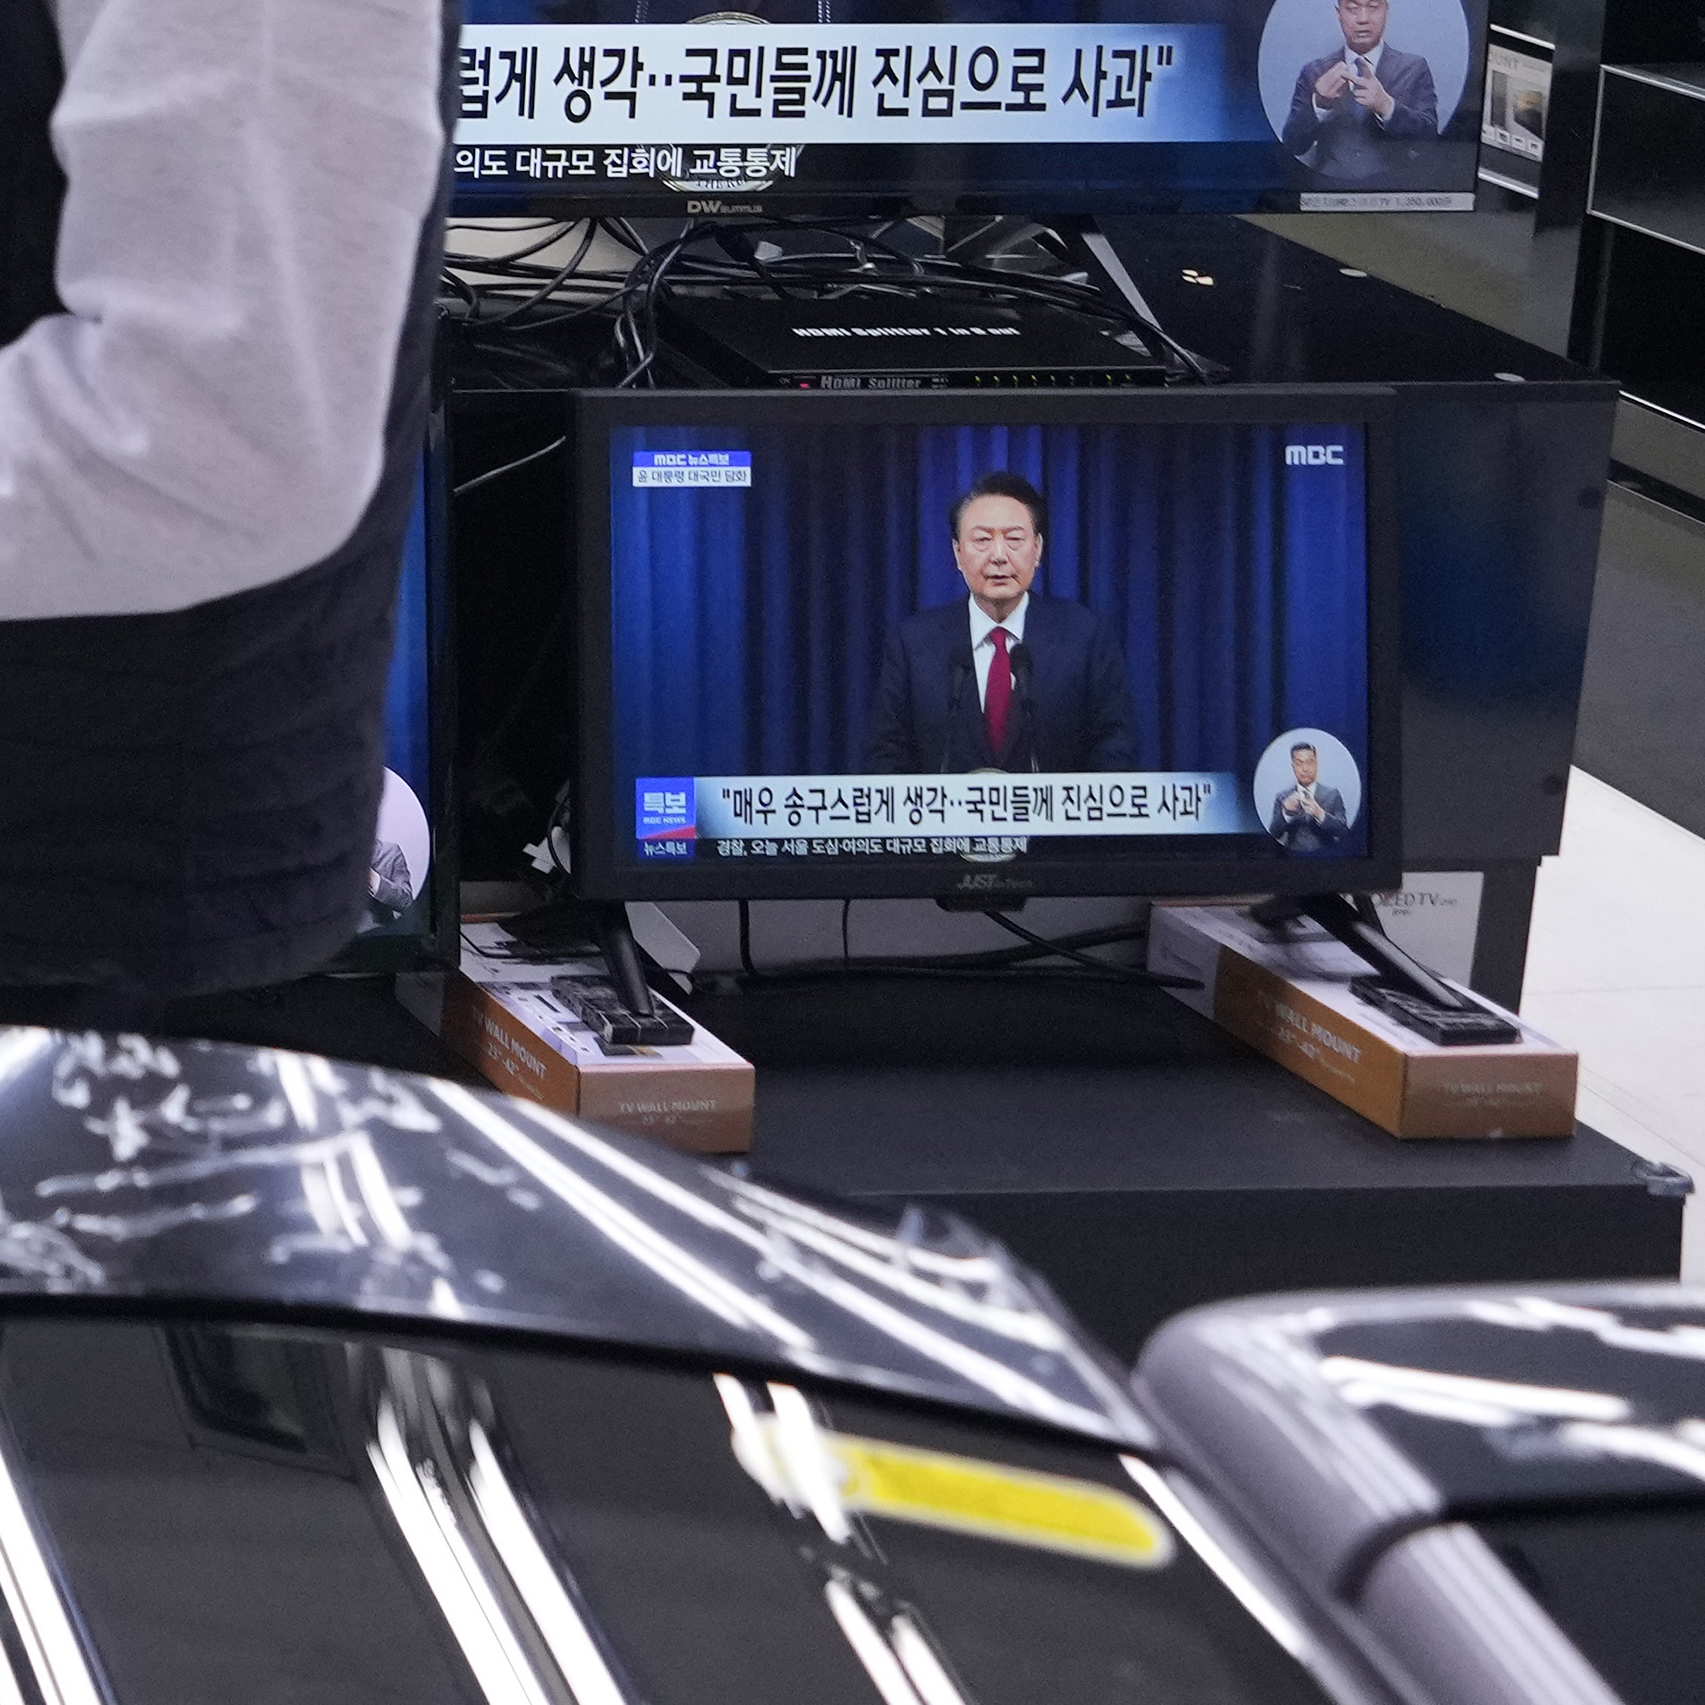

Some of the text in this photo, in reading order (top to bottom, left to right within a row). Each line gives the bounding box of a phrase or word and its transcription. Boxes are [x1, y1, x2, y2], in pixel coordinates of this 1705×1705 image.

[460, 45, 535, 120] 럽게
[871, 44, 1047, 118] 진심으로
[1061, 43, 1174, 118] 사과"
[455, 148, 797, 179] 의도 대규모 집회에 교통통제
[654, 454, 730, 465] MBC 뉴스특보
[1286, 444, 1344, 465] MBC
[637, 469, 748, 484] 윤 대통령 대국민 담화
[643, 792, 687, 814] 특보
[721, 787, 776, 826] "매우
[784, 786, 895, 826] 송구스럽게
[1061, 784, 1150, 821] 진심으로
[1157, 783, 1211, 821] 사과"
[644, 843, 688, 856] 뉴스특보
[716, 840, 748, 857] 경찰,
[751, 841, 778, 856] 오늘
[781, 840, 808, 855] 서울
[886, 839, 927, 854] 대규모
[930, 839, 971, 854] 집회에
[973, 837, 1028, 855] 교통통제
[485, 1019, 509, 1048] WALL
[510, 1036, 547, 1079] MOUNT
[671, 1099, 718, 1111] MOUNT
